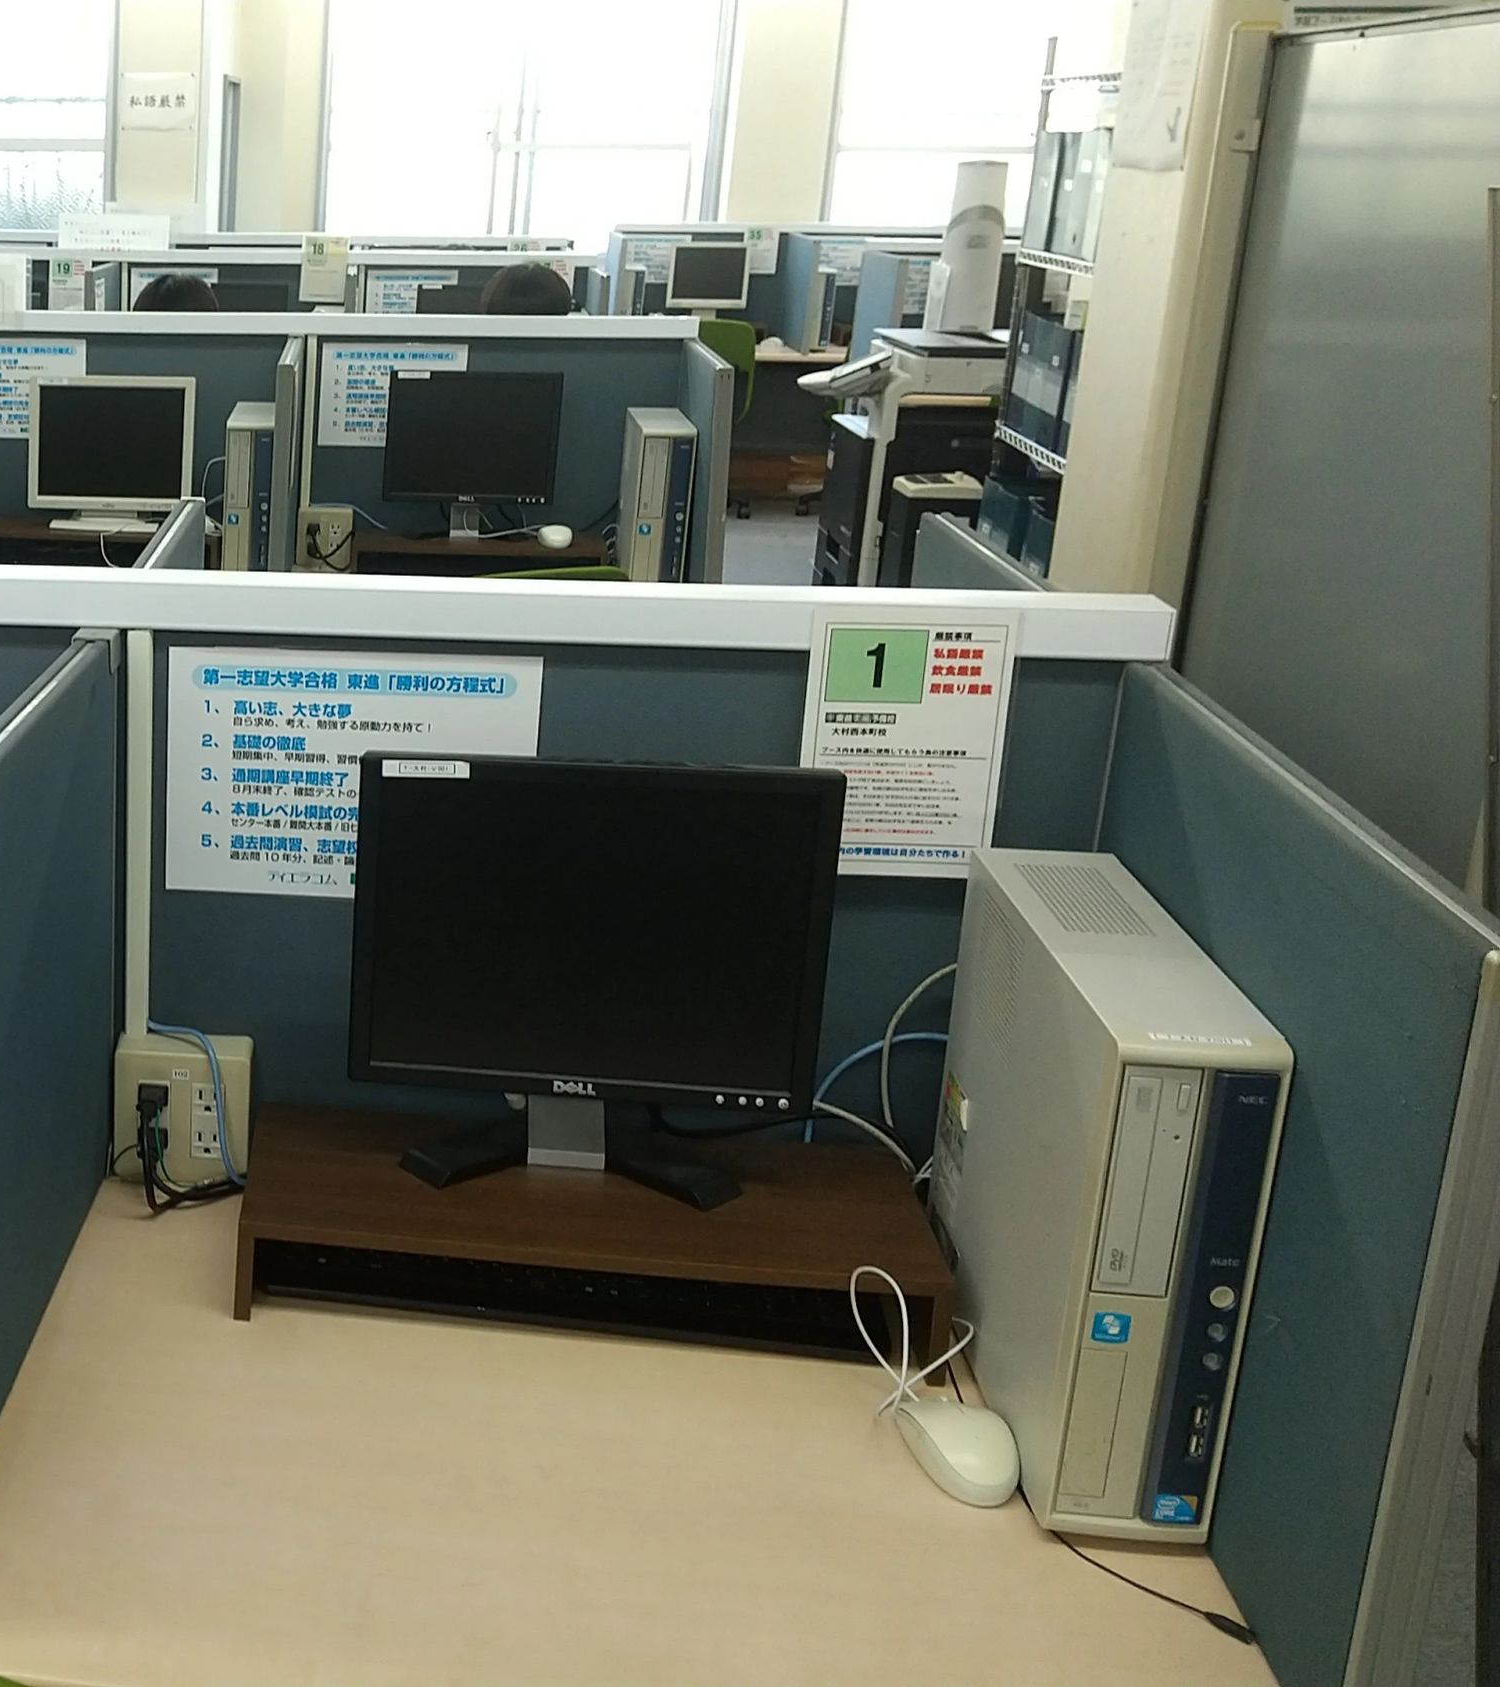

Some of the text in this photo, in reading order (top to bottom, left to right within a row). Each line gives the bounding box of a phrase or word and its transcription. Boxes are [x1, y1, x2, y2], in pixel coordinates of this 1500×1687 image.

[130, 93, 186, 108] 私語厳禁
[312, 243, 324, 255] 18
[56, 263, 70, 274] 19
[458, 495, 475, 503] DELL
[934, 648, 984, 660] 私語厳禁
[867, 643, 886, 688] 1
[931, 665, 983, 677] 飲食厳禁
[203, 667, 505, 695] 第一志望大学合格 東進「勝利の方程式」
[929, 683, 993, 695] 居眠り厳禁
[233, 700, 352, 719] 高い志、大きな夢
[831, 728, 887, 738] 大村西本町校
[232, 734, 306, 751] 基礎の徹底
[232, 767, 349, 787] 通期講座早期終了
[267, 870, 338, 885] ティエラコム
[553, 1080, 596, 1096] DELL
[1238, 1095, 1268, 1105] NEC
[1210, 1257, 1240, 1267] Mate
